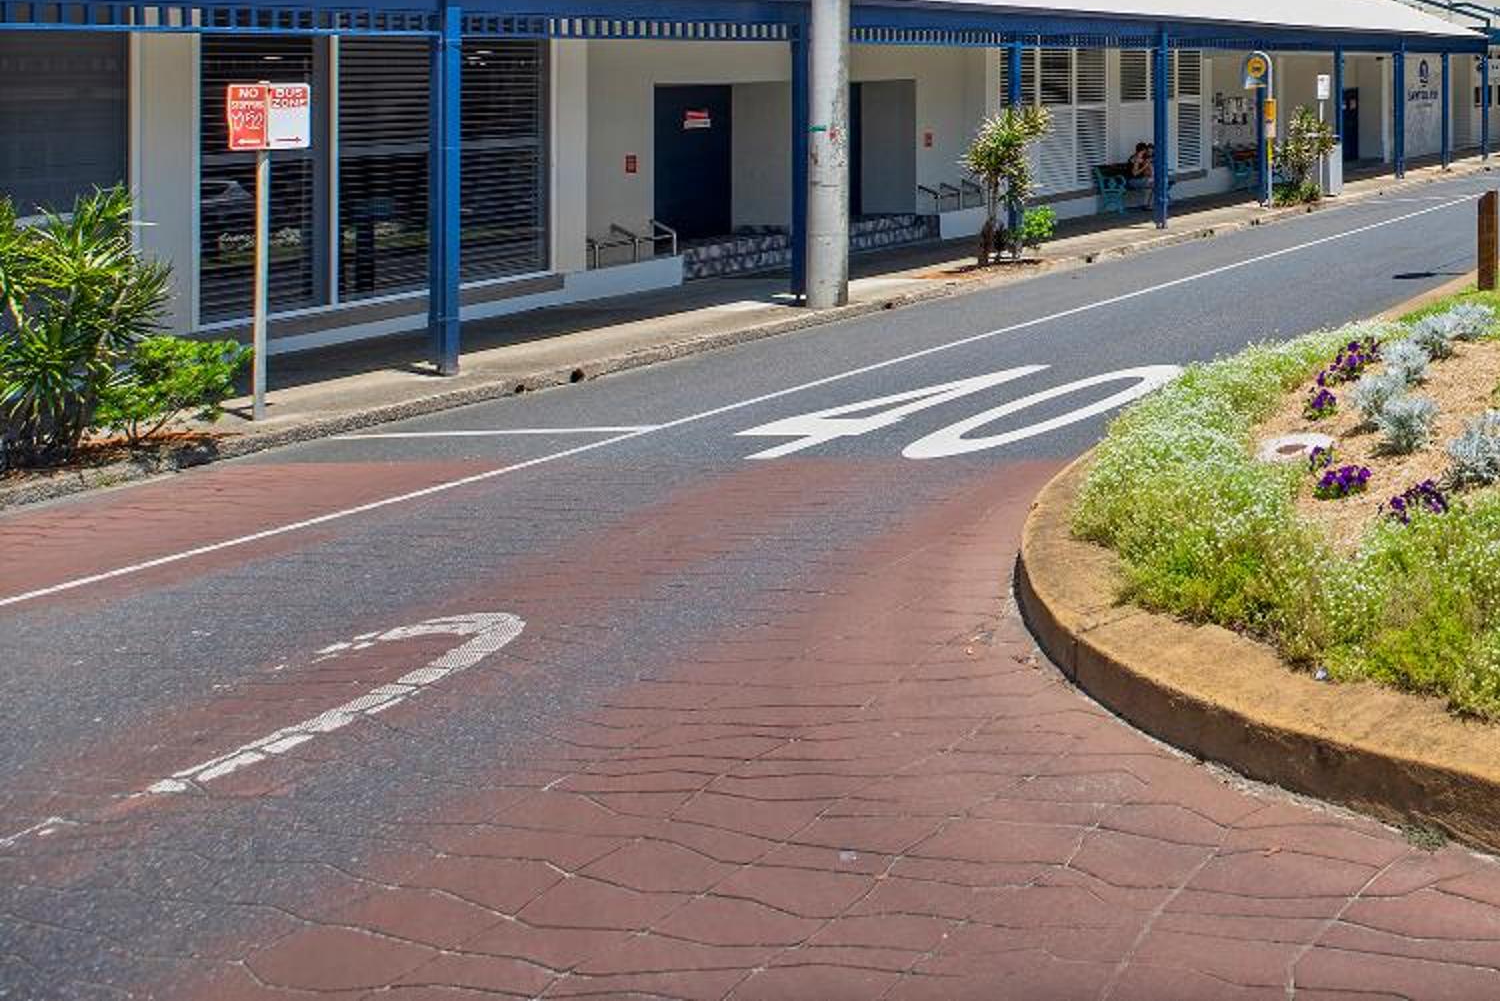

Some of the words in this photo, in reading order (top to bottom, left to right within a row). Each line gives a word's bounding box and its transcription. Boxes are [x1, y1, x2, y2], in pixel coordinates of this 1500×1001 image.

[239, 88, 259, 98] NO
[276, 88, 303, 98] BUS
[272, 99, 307, 109] ZONE
[734, 364, 1186, 460] 40
